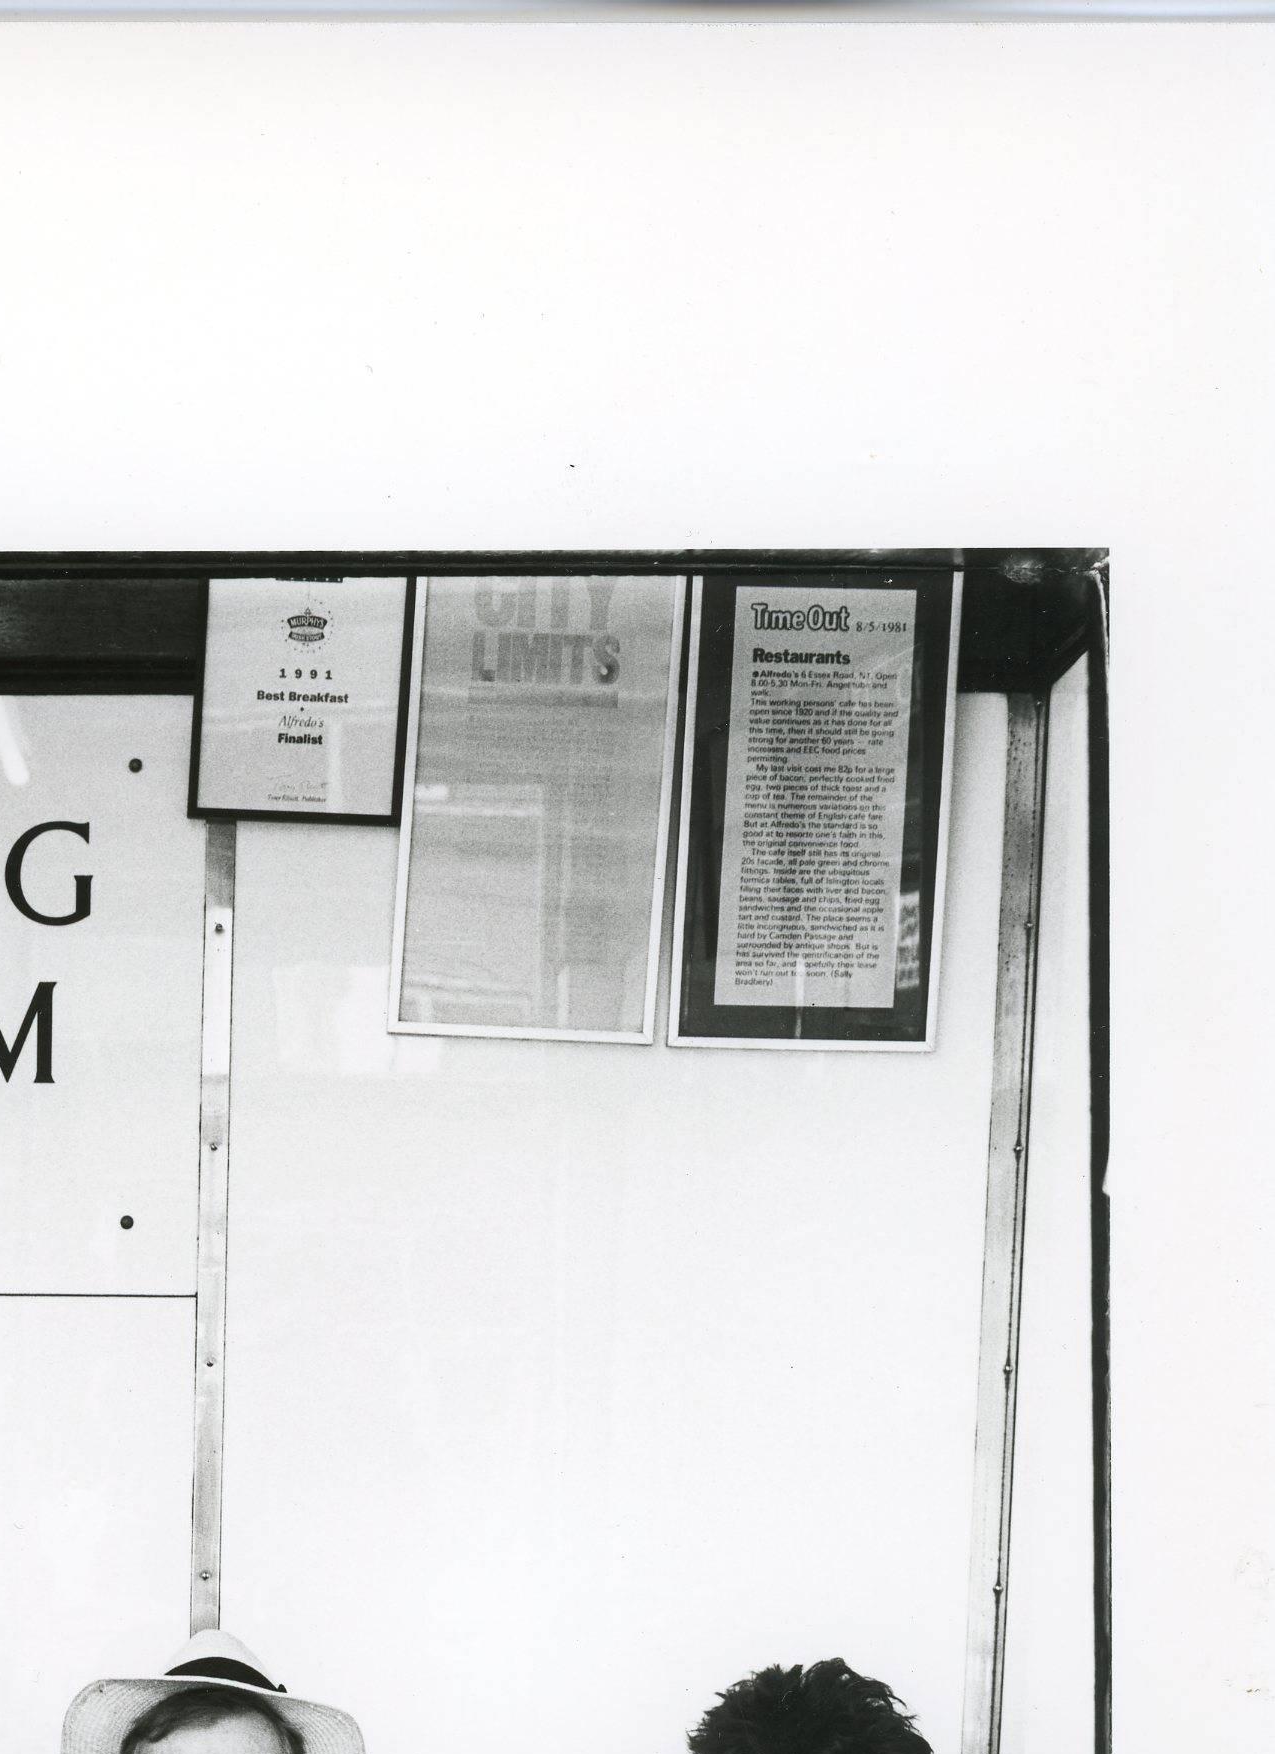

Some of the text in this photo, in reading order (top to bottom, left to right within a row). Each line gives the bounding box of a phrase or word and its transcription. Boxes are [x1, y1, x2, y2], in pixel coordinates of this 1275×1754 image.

[751, 603, 907, 633] Time Out 8/5/1981
[470, 630, 621, 685] LIMITS
[752, 648, 851, 665] Restaurants
[760, 670, 798, 678] Alfredo's
[256, 690, 349, 703] Best Breakfast
[769, 698, 801, 707] working
[278, 715, 325, 729] Alfredo's
[277, 733, 323, 745] Finalist
[748, 736, 773, 744] strong
